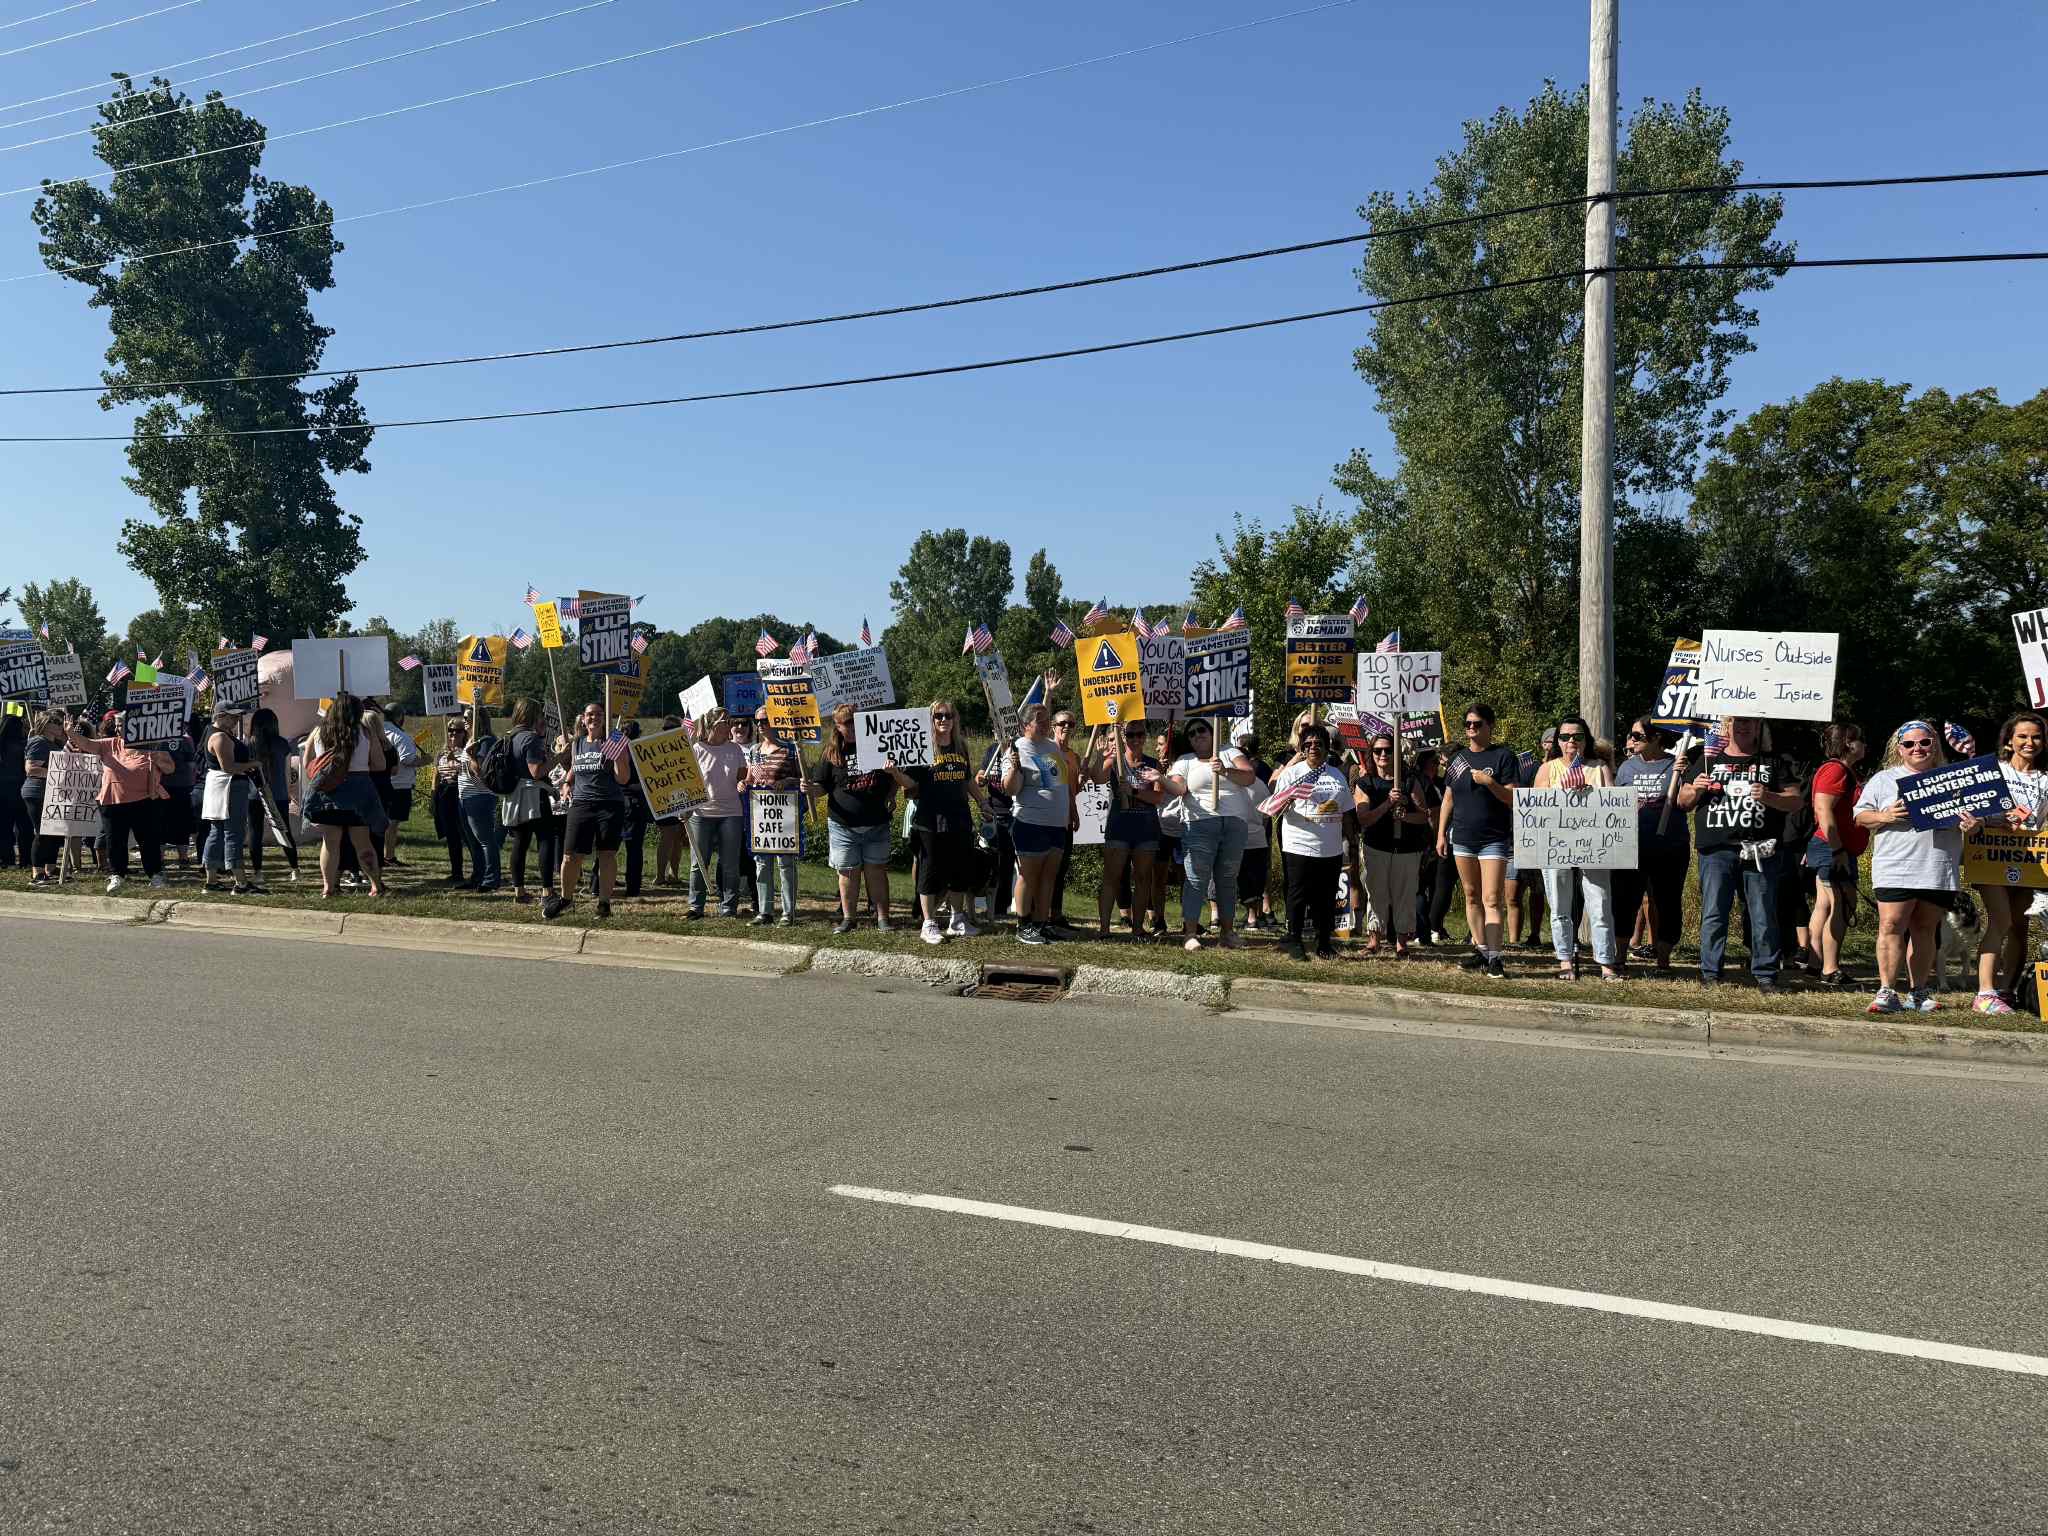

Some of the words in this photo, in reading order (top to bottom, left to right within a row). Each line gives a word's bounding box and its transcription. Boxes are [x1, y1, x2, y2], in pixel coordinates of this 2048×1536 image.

[595, 614, 629, 631] ULP
[1306, 625, 1347, 635] DEMAND
[582, 629, 630, 664] STRIKE
[1138, 639, 1165, 661] YOU
[1168, 639, 1185, 659] CA
[1187, 637, 1248, 654] TEAMSTERS
[1295, 641, 1347, 651] BETTER
[1704, 638, 1763, 663] Nurses
[1775, 640, 1833, 665] Outside
[8, 654, 42, 668] ULP
[1203, 648, 1248, 670] ULP
[1297, 655, 1344, 665] NURSE
[1363, 655, 1388, 674] 10
[1391, 654, 1413, 672] TO
[1419, 654, 1432, 672] 1
[226, 663, 256, 679] ULP
[772, 666, 804, 677] DEMAND
[1139, 661, 1184, 676] PATIENTS
[0, 665, 46, 694] STRIKE
[466, 673, 501, 685] UNSAFE
[1082, 672, 1137, 687] UNDERSTAFFED
[1148, 676, 1159, 689] IF
[1164, 675, 1185, 690] YOU
[1187, 665, 1248, 707] STRIKE
[1292, 675, 1346, 685] PATIENT
[1368, 675, 1391, 691] IS
[1398, 671, 1441, 694] NOT
[1666, 673, 1687, 684] ON
[217, 674, 258, 704] STRIKE
[432, 681, 452, 693] SAVE
[767, 683, 809, 694] BETTER
[1094, 683, 1137, 697] UNSAFE
[1295, 688, 1345, 698] RATIOS
[1704, 678, 1760, 700] Trouble
[1773, 682, 1824, 703] Inside
[129, 692, 184, 701] TEAMSTERS
[433, 695, 454, 708] LIVES
[774, 697, 808, 707] NURSE
[1657, 685, 1706, 719] STR
[142, 701, 183, 715] ULP
[127, 713, 182, 742] STRIKE
[773, 716, 816, 727] PATIENT
[865, 713, 921, 736] Nurses
[1400, 717, 1434, 731] ESERVE
[777, 729, 817, 739] RAOS
[878, 731, 928, 752] STRIKE
[635, 734, 691, 762] PATIENTS
[649, 755, 689, 773] before
[887, 749, 928, 766] BACK
[48, 770, 102, 788] STRIKIN
[645, 766, 697, 793] PROFITS
[1916, 780, 1921, 788] I
[1922, 764, 1980, 787] SUPPORT
[1903, 776, 1975, 802] TEAMSTERS
[1975, 769, 2001, 784] RNs
[52, 788, 73, 803] FOR
[760, 794, 788, 806] HONK
[1517, 788, 1560, 808] Would
[1599, 789, 1631, 808] Want
[1919, 796, 1961, 815] HENRY
[1963, 789, 1998, 803] FORD
[764, 808, 783, 820] FOR
[1932, 799, 1991, 820] GENESYS
[759, 822, 784, 833] SAFE
[1518, 809, 1551, 828] Your
[1559, 809, 1600, 830] Loved
[1605, 812, 1631, 829] One
[754, 836, 796, 848] RATIOS
[1520, 832, 1535, 848] to
[1548, 832, 1567, 848] be
[1575, 837, 1593, 853] my
[1547, 848, 1607, 865] Patient?
[1987, 848, 2048, 863] UNSAF
